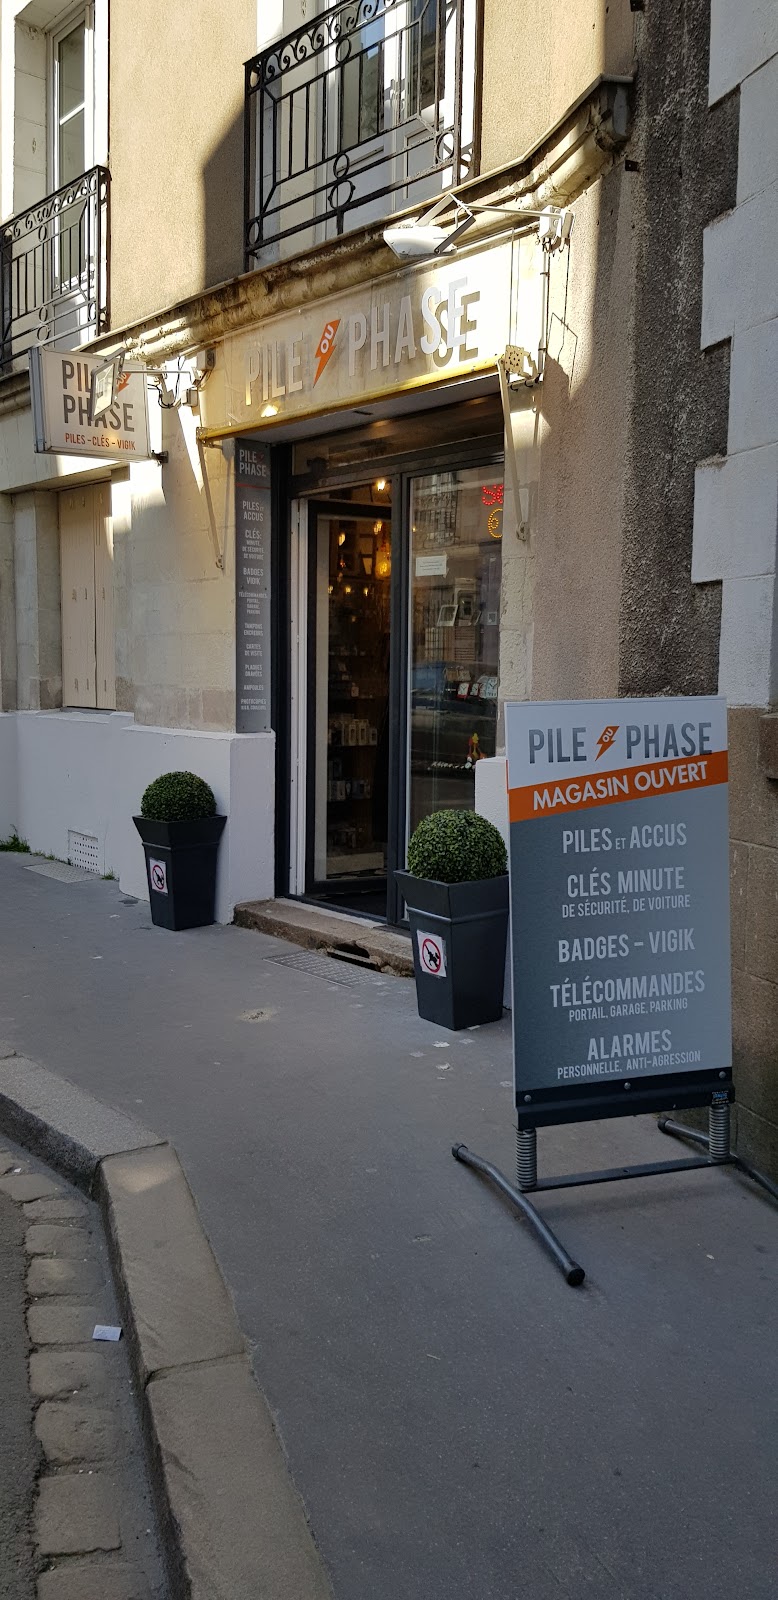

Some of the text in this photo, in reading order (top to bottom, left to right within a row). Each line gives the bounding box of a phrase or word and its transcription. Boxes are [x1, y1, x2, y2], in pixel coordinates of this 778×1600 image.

[245, 276, 467, 405] PILE OU PHASE
[62, 360, 92, 392] PIL
[65, 433, 86, 445] PILES
[92, 435, 109, 447] CLÉS
[117, 439, 136, 450] VIGIK
[240, 450, 257, 462] PILE
[240, 462, 266, 476] PHASE
[243, 501, 259, 511] PILES
[244, 512, 264, 522] ACCUS
[528, 722, 712, 764] PILE OU PHASE
[533, 760, 708, 811] MAGASIN OUVERT
[562, 822, 687, 854] PILES ET ACCUS
[567, 866, 685, 898] CLÉS MINUTE
[562, 894, 691, 918] DE SÉCURITÉ, DE VOITURE
[558, 933, 629, 963] BADGES
[649, 927, 695, 954] VIGIK
[550, 970, 705, 1008] TÉLÉCOMMANDES
[569, 997, 688, 1022] PORTAIL, GARAGE, PARKING
[587, 1029, 672, 1061] ALARMES
[557, 1050, 701, 1079] PERSONNELLE, ANTI-AGRESSION
